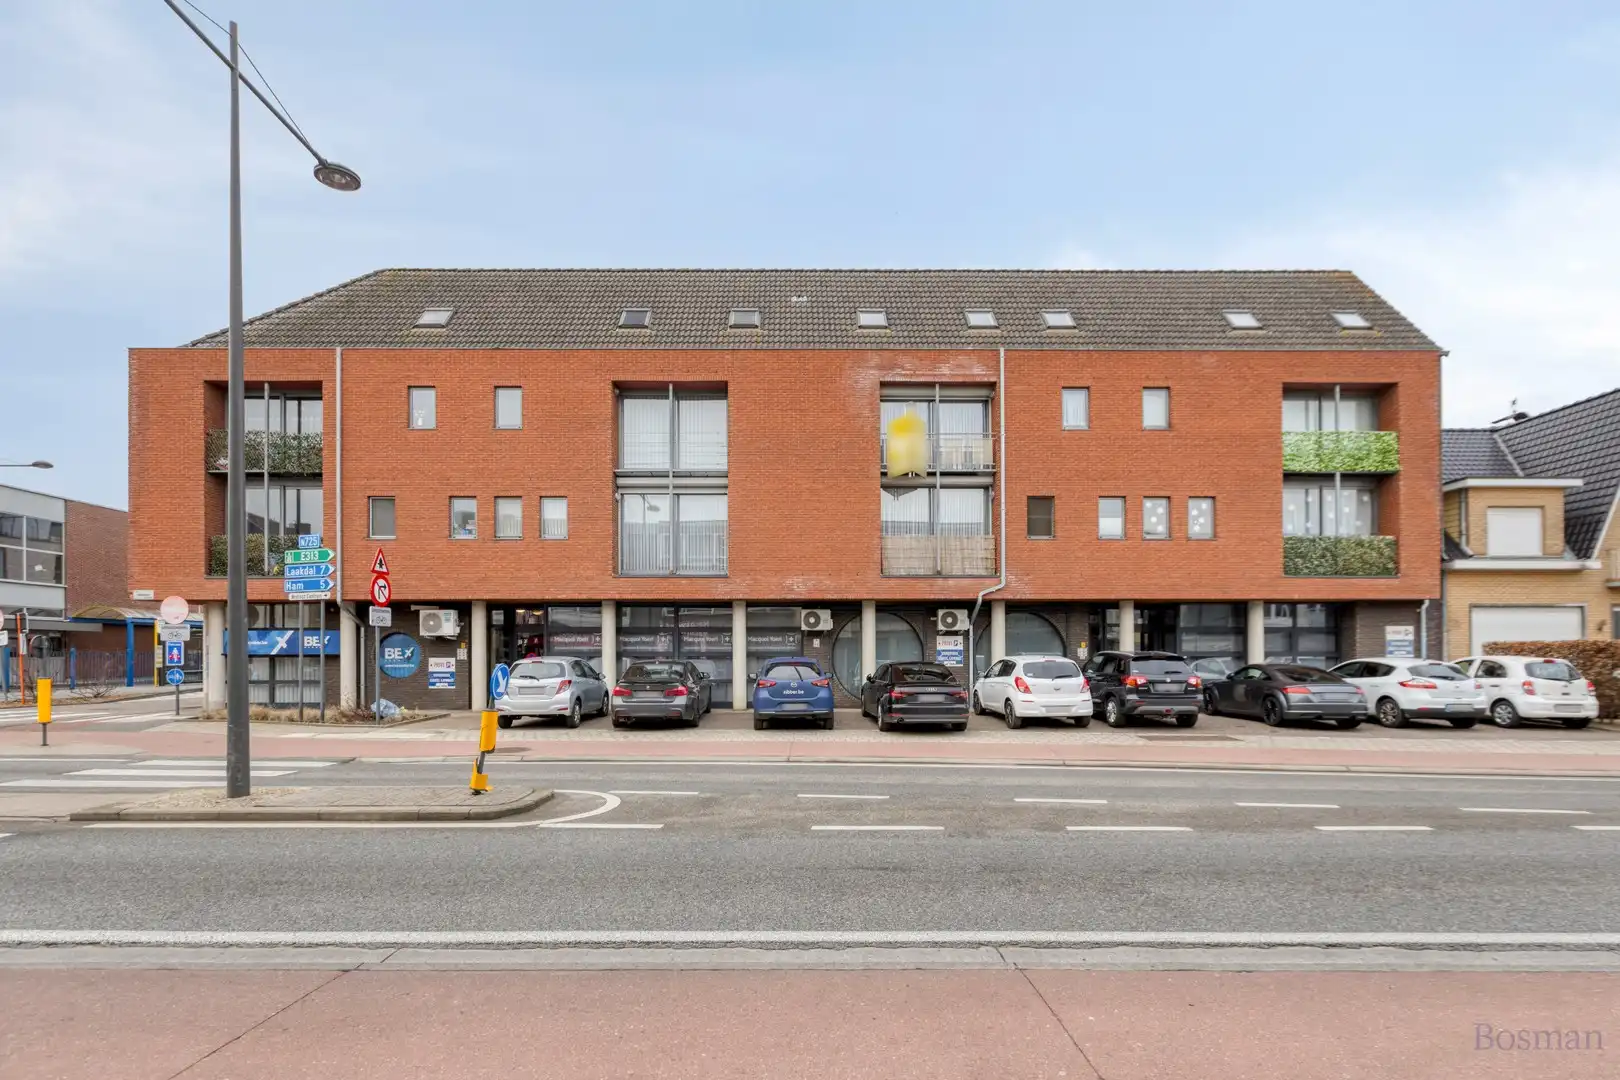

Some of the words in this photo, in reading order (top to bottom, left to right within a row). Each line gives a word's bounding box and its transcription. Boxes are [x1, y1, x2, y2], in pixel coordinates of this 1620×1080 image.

[300, 536, 318, 546] N725
[301, 551, 319, 560] E313
[286, 566, 316, 576] Laakdal
[320, 565, 326, 575] 7
[286, 581, 304, 590] Ham
[320, 580, 326, 589] 5
